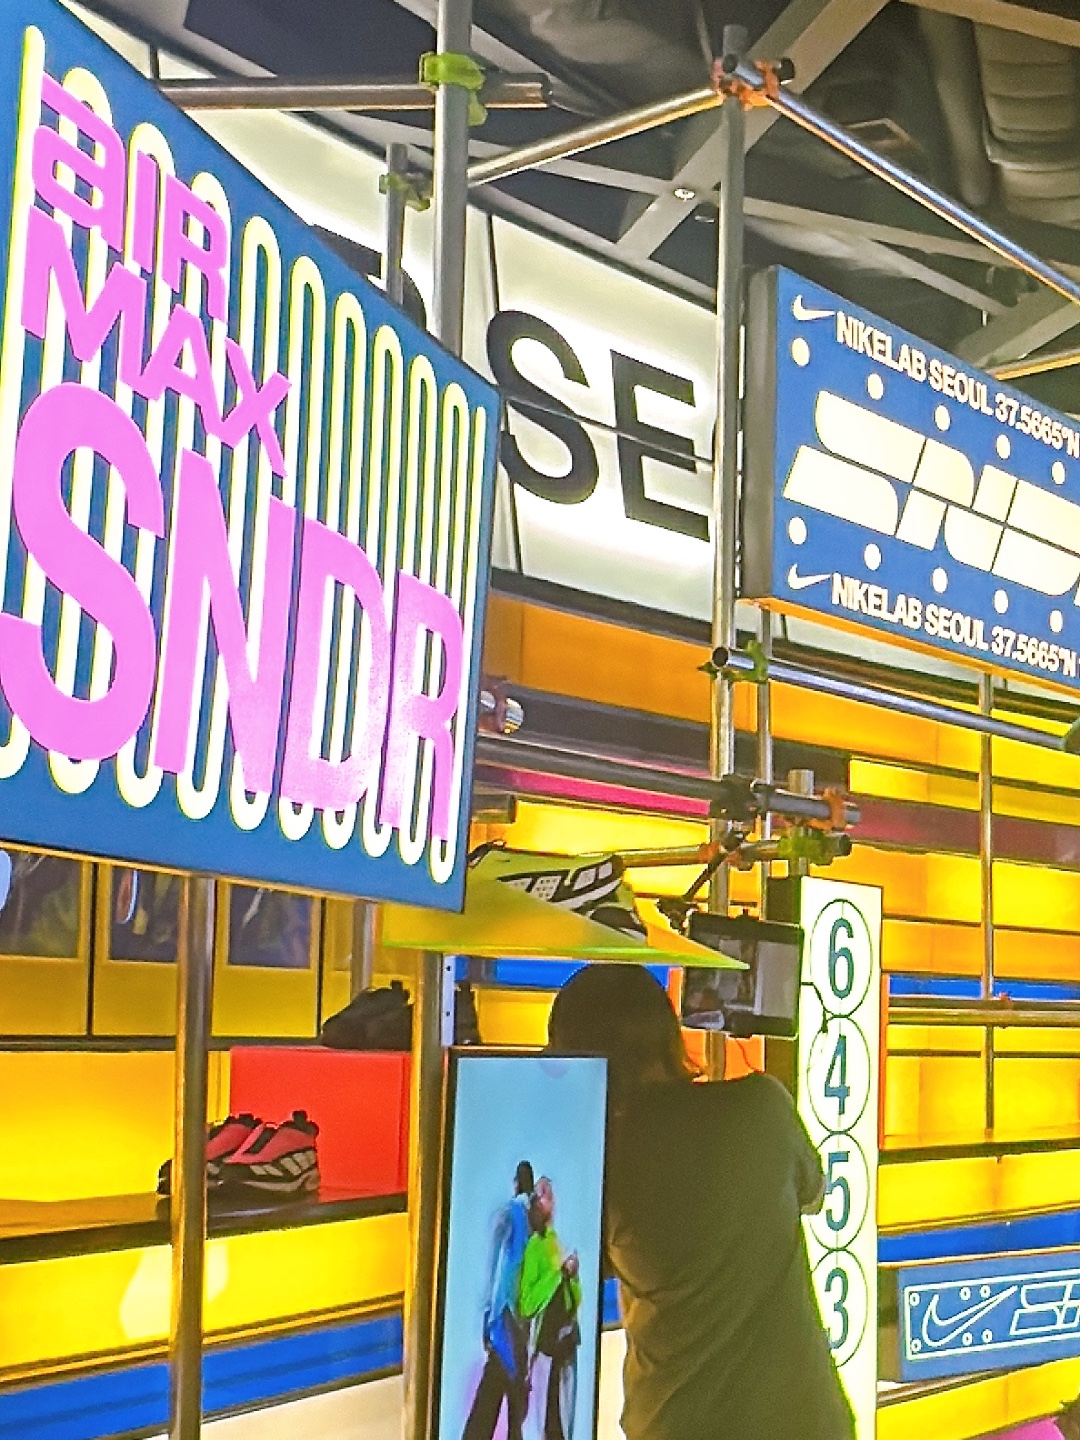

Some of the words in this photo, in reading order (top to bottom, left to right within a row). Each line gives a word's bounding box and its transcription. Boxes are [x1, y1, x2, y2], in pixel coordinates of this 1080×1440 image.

[22, 204, 292, 478] MAX
[835, 310, 927, 383] NIKELAB
[929, 359, 993, 416] SEOUL
[0, 382, 463, 841] SNDR
[831, 572, 922, 630] NIKELAB
[924, 603, 989, 651] SEOUL
